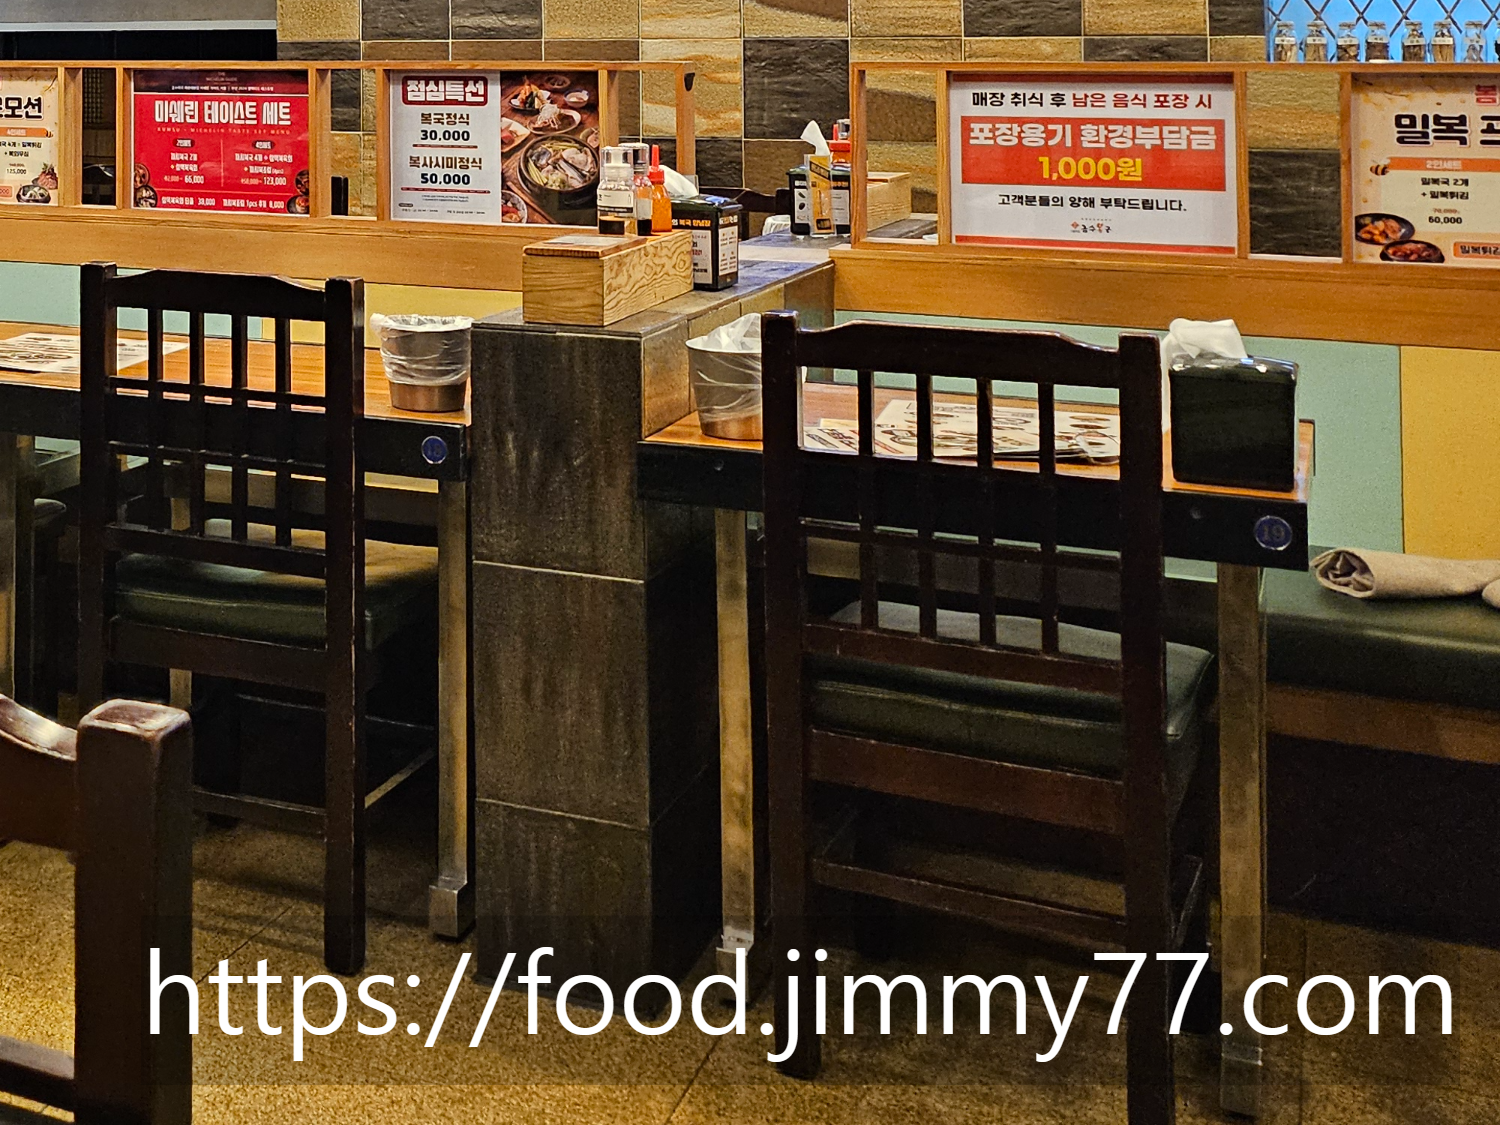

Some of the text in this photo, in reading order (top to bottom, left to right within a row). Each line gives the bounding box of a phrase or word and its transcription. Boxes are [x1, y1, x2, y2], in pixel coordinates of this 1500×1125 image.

[407, 80, 485, 102] 점심특선
[972, 92, 1212, 109] 매장 취식 후 남은 음식 포장 시
[154, 100, 291, 125] 미쉐린 테이스트 세트
[420, 112, 470, 126] 복국정식
[420, 129, 470, 142] 30,000
[969, 122, 1217, 150] 포장용기 환경부담금
[1394, 113, 1469, 146] 밀복
[409, 155, 483, 170] 복사시미정식
[1038, 156, 1142, 181] 1,000원
[420, 172, 471, 186] 50,000
[998, 194, 1187, 212] 고객분들의 양해 부탁드립니다.
